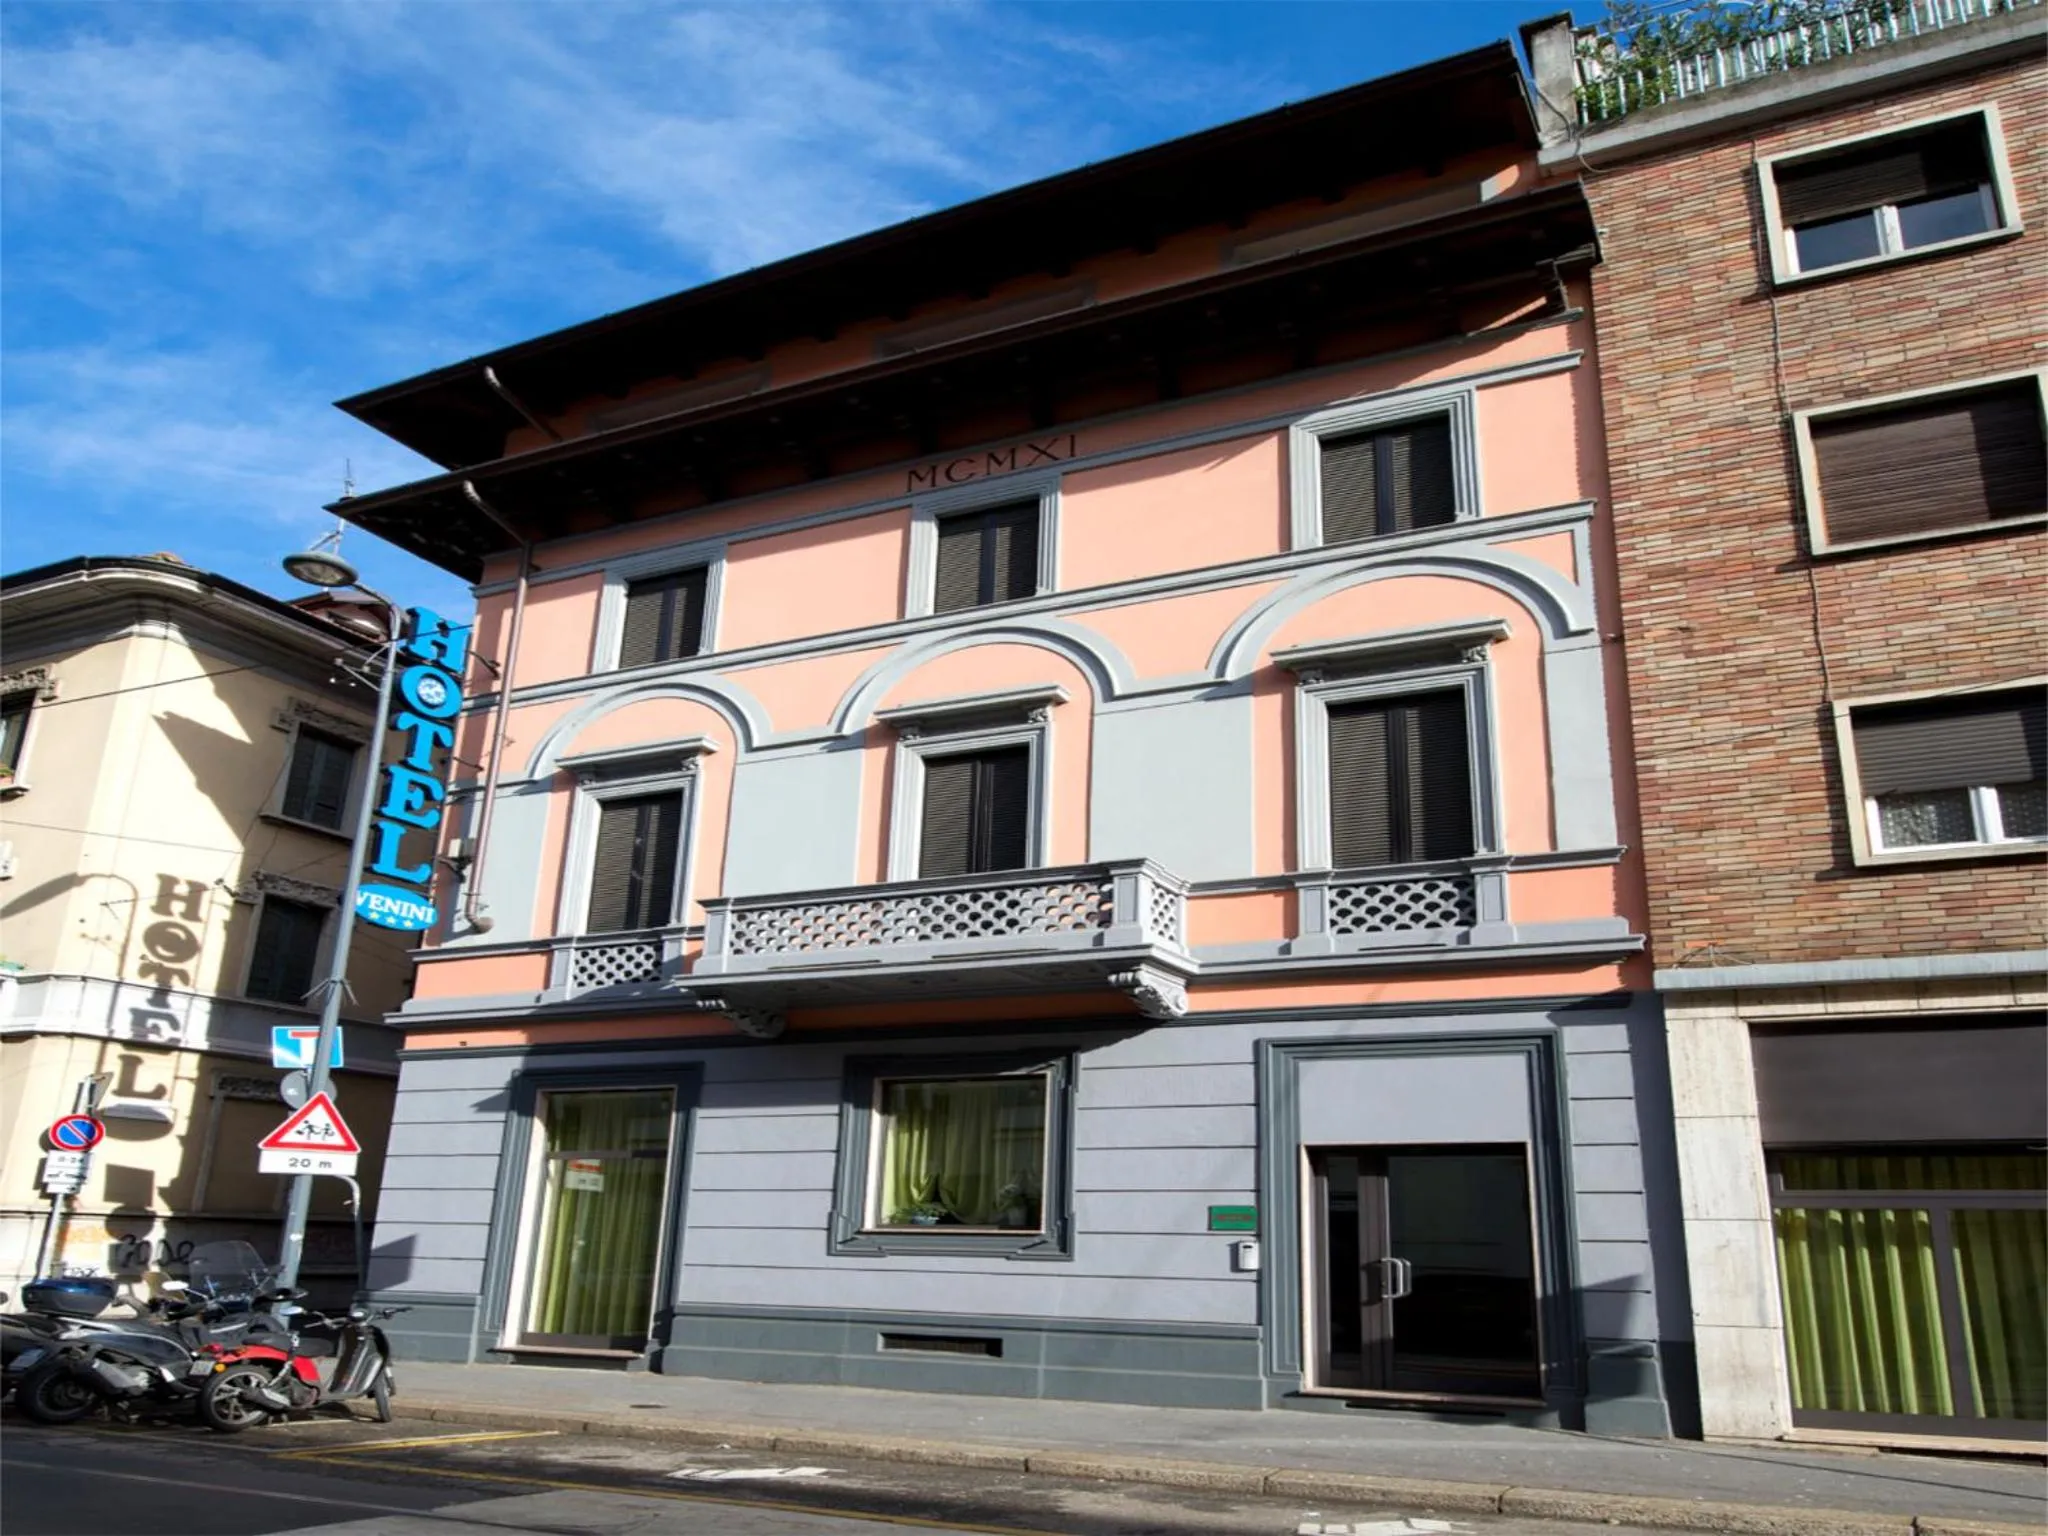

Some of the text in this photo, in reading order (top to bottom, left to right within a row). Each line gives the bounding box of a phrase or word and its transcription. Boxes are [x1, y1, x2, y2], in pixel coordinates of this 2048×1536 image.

[907, 434, 1076, 493] MCMXI
[371, 606, 471, 885] HOTEL
[356, 891, 435, 924] VENINI
[112, 873, 208, 1101] HOTEL
[288, 1157, 332, 1168] 20 m
